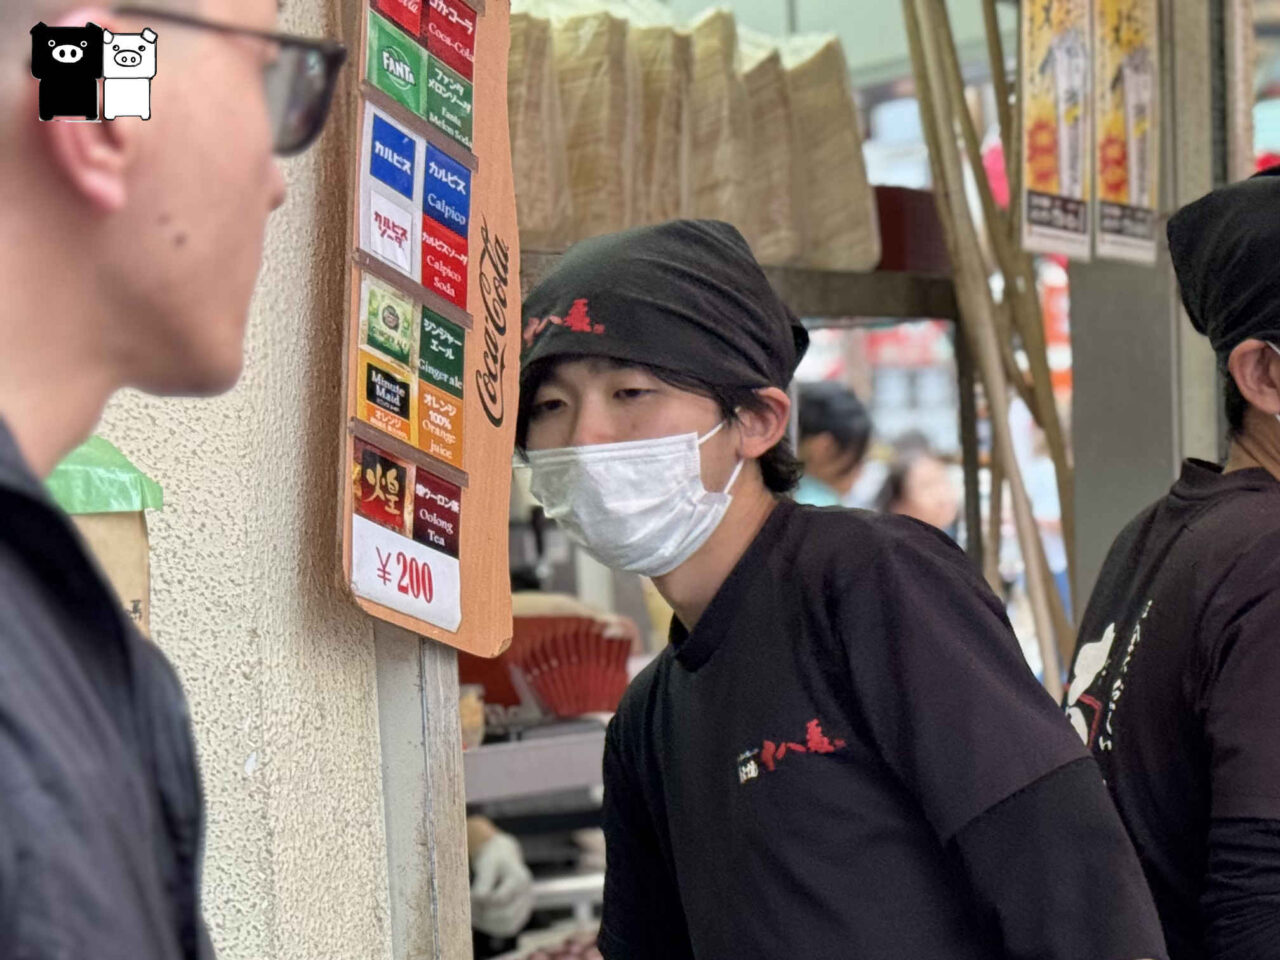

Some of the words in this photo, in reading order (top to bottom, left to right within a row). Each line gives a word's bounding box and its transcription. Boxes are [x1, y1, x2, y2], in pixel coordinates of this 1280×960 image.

[428, 22, 474, 62] Coca-Cola
[382, 50, 416, 85] FANTA
[428, 78, 472, 113] メロンソーダ
[434, 68, 465, 97] ファンタ
[374, 140, 412, 176] カルピス
[428, 161, 467, 195] カルピス
[427, 192, 466, 226] Calpico
[374, 210, 408, 241] カルピス
[422, 231, 468, 266] カルピスソーダ
[426, 254, 462, 283] Calpico
[433, 276, 456, 298] Soda
[423, 318, 463, 346] ジンジャー
[475, 211, 511, 428] Coca-Cola
[430, 338, 456, 361] エール
[371, 369, 406, 398] Minute
[418, 358, 449, 382] Ginger
[448, 375, 464, 390] ale
[375, 385, 401, 408] Maid
[423, 392, 457, 418] オレンジ
[422, 419, 457, 445] Orange
[429, 410, 453, 431] 100%
[365, 462, 401, 516] 煌
[419, 508, 454, 535] Oolong
[427, 529, 447, 547] Tea
